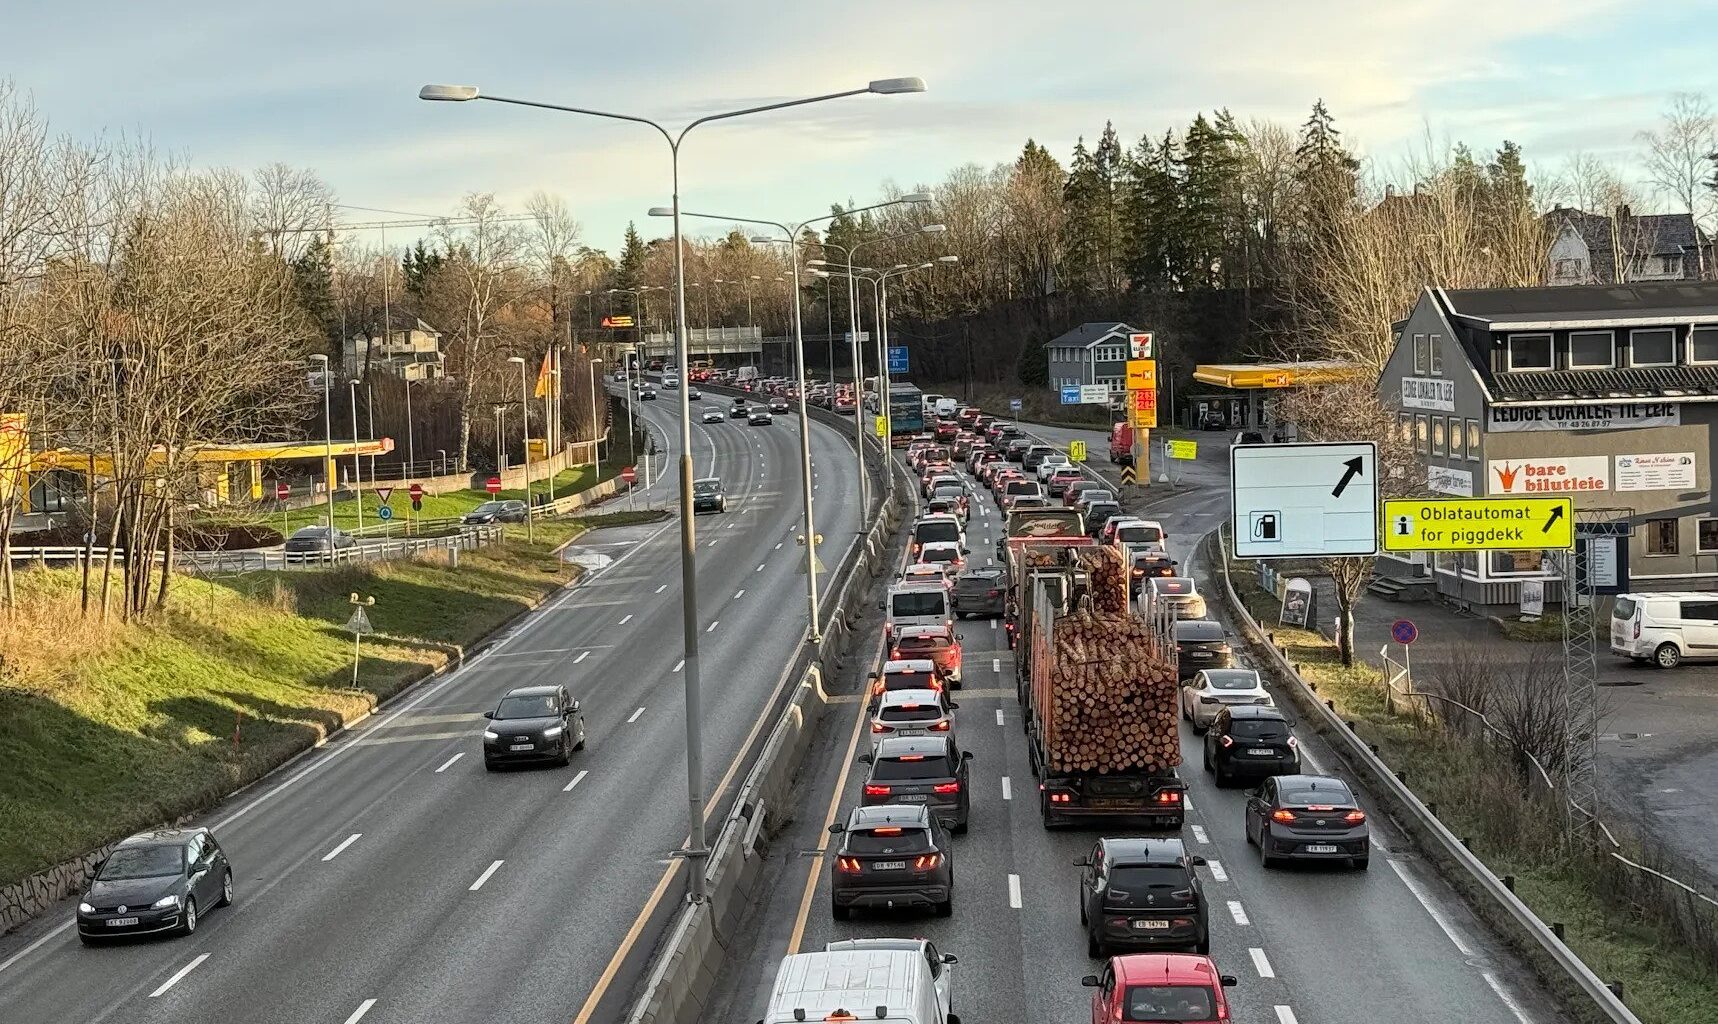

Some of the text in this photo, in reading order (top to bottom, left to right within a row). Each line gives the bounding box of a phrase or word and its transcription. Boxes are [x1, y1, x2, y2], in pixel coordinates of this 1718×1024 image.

[1493, 407, 1543, 422] LEDIGE
[1548, 405, 1613, 420] LOKALER
[1645, 402, 1675, 418] LEIE
[1525, 464, 1567, 477] bare
[1525, 476, 1605, 492] bilutleie
[1420, 506, 1531, 521] Oblatautomat
[1421, 527, 1524, 545] for piggdekk
